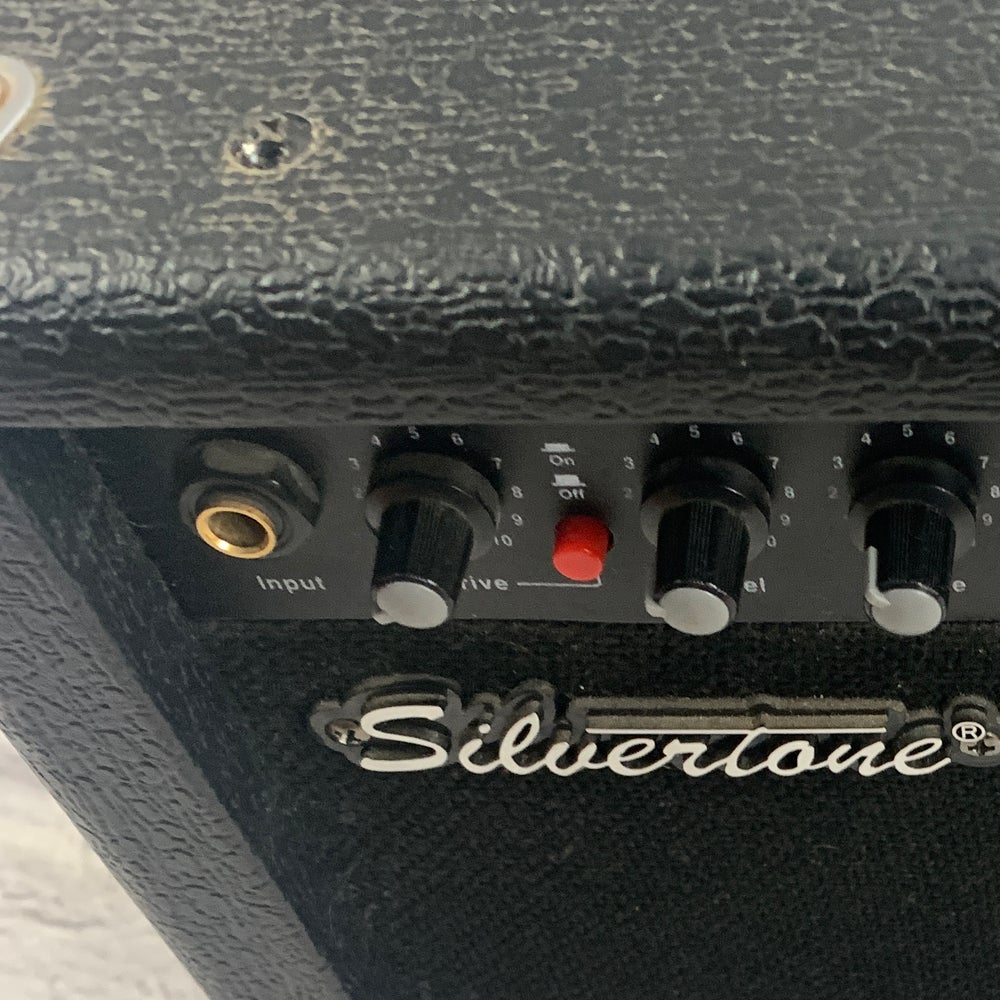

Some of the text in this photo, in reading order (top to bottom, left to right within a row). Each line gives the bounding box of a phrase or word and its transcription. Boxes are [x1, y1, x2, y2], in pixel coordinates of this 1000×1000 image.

[688, 424, 701, 439] 5
[902, 424, 914, 438] 5
[944, 431, 956, 445] 6
[649, 432, 660, 446] 4
[732, 431, 744, 446] 6
[861, 432, 872, 446] 4
[549, 454, 576, 467] On
[623, 456, 635, 470] 3
[768, 456, 779, 470] 7
[832, 455, 844, 470] 3
[979, 455, 989, 470] 7
[511, 485, 524, 499] 8
[559, 488, 586, 500] Off
[784, 485, 796, 499] 8
[990, 485, 1000, 499] 8
[511, 513, 524, 527] 9
[781, 512, 792, 527] 9
[982, 512, 994, 527] 9
[494, 534, 513, 547] 10
[767, 534, 778, 548] 0
[256, 575, 327, 594] Input
[461, 575, 509, 591] rive
[360, 705, 951, 778] Silvertone
